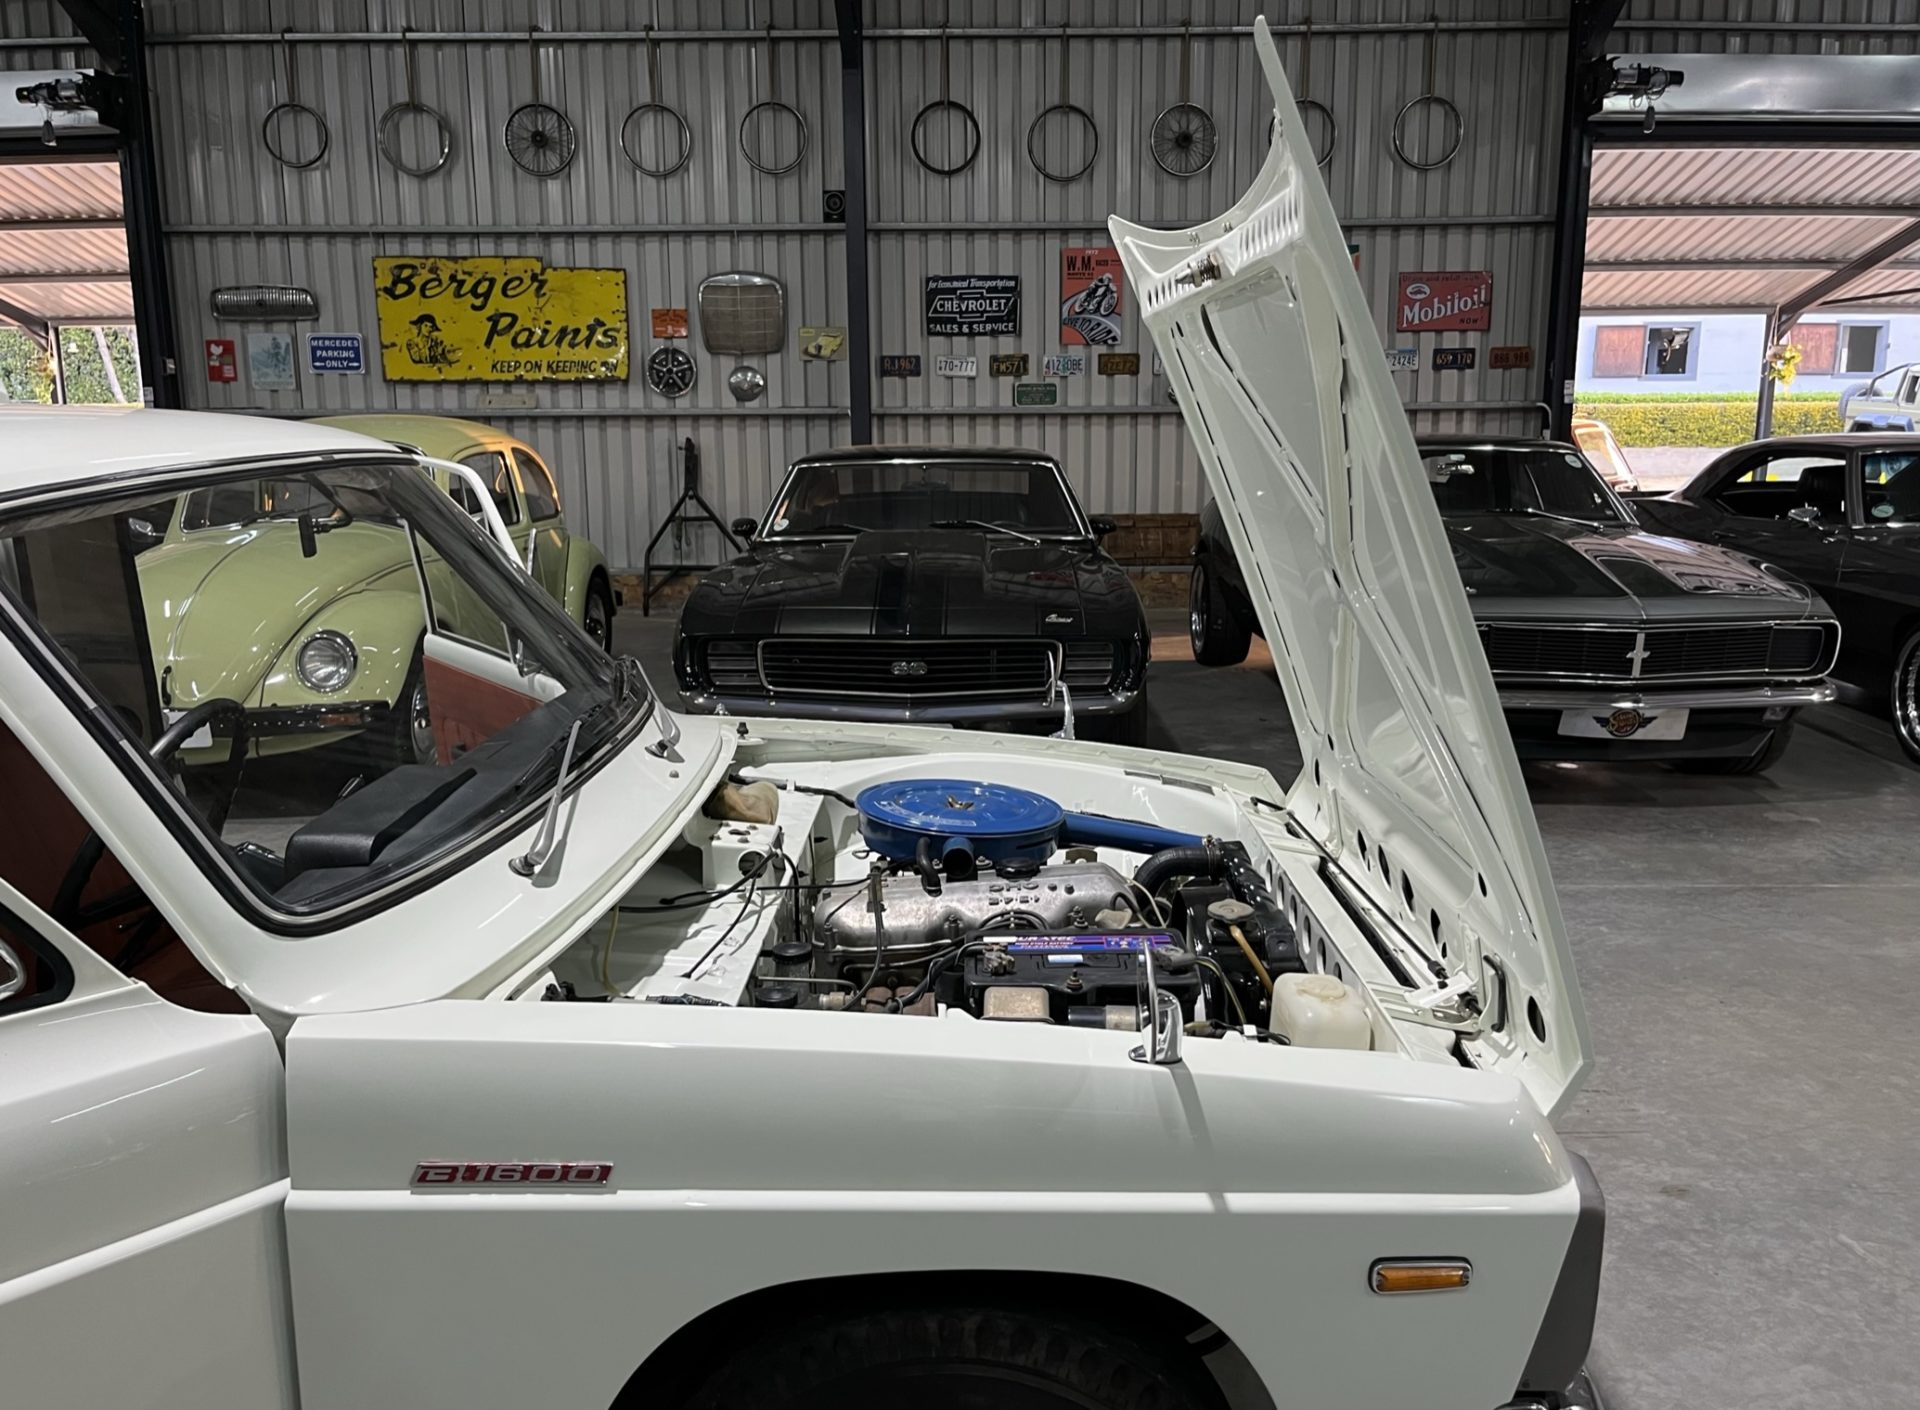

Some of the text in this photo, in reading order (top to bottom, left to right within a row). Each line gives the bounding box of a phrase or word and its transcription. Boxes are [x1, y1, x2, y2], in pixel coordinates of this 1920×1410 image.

[1067, 255, 1095, 271] W.M.
[383, 263, 548, 311] Berger
[970, 278, 1015, 290] Transportation
[936, 299, 1007, 312] CHEVROLET
[484, 312, 622, 350] Paints
[929, 322, 1015, 333] SALES & SERVICE
[311, 339, 359, 347] MERCEDES
[316, 350, 355, 358] PARKING
[325, 360, 348, 368] ONLY
[491, 360, 523, 374] KEEP
[524, 360, 543, 373] ON
